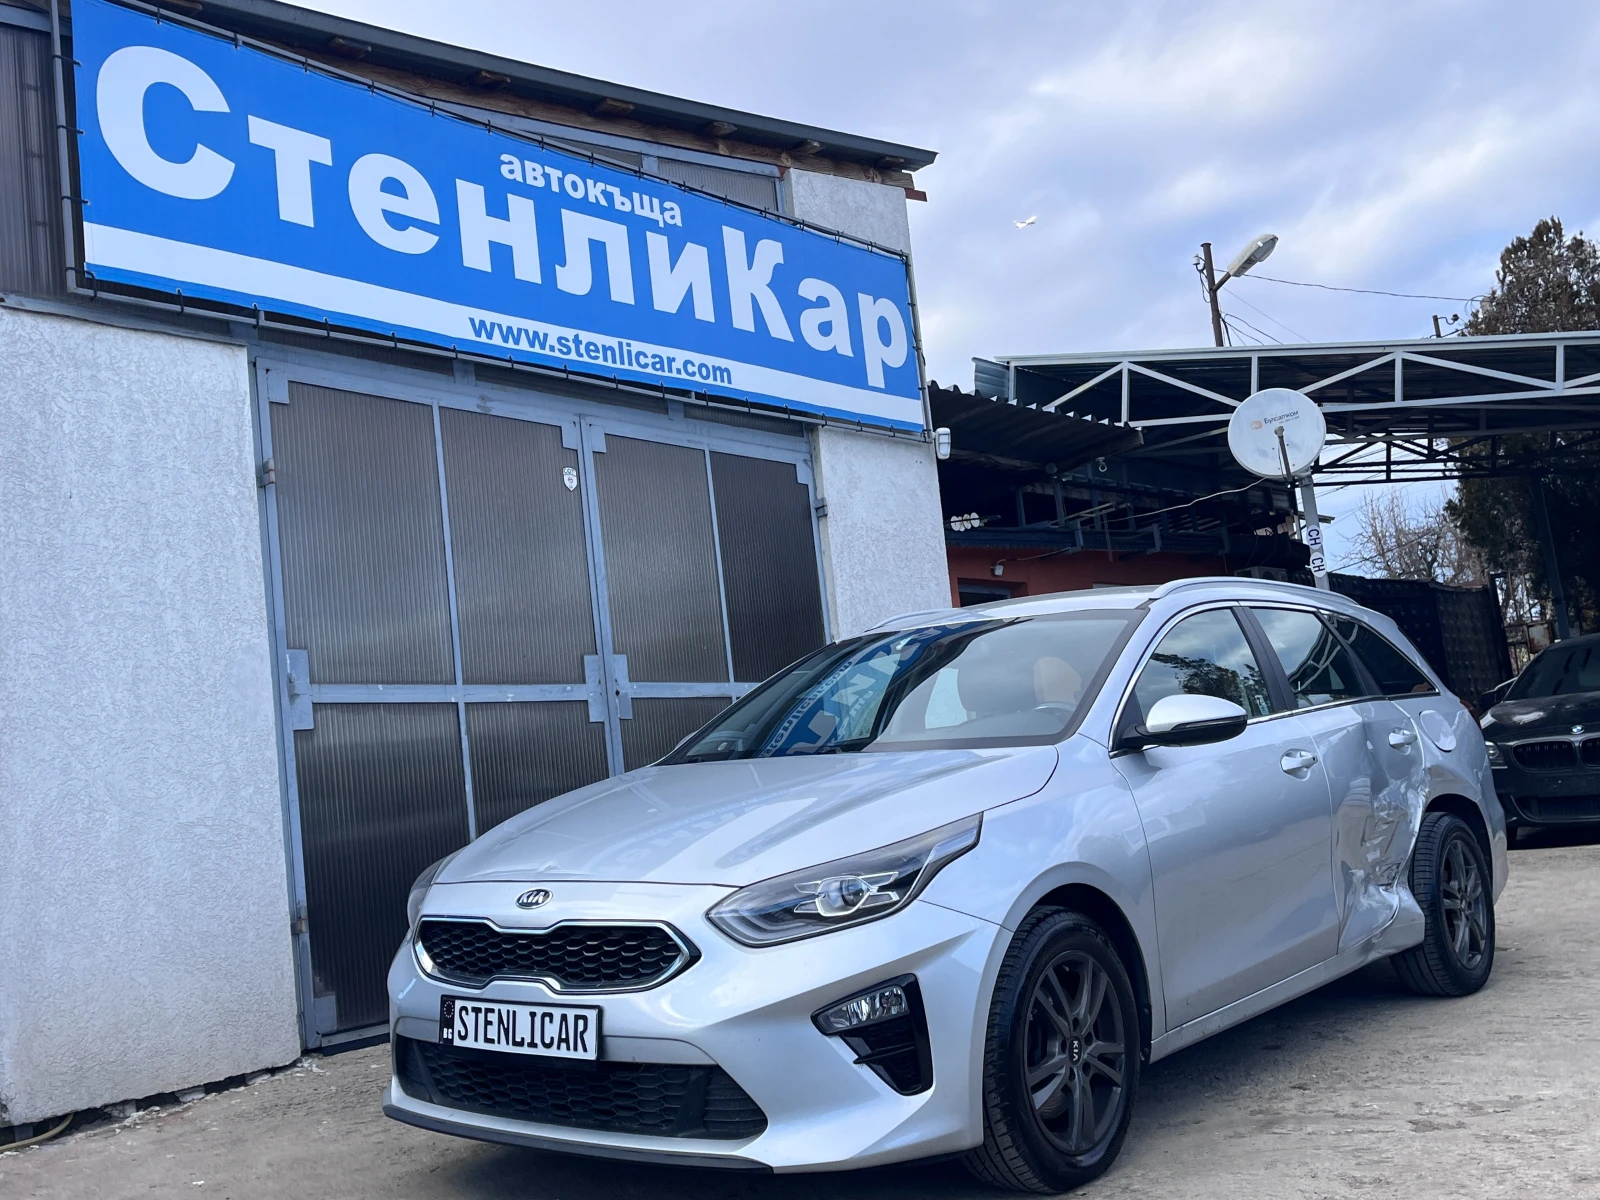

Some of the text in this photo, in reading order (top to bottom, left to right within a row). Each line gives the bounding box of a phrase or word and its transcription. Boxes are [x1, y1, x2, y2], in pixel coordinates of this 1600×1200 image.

[501, 153, 682, 227] автокъща
[96, 45, 908, 388] СтенлиКар
[469, 317, 733, 385] www.stenlicar.com
[1308, 528, 1321, 546] CH
[1311, 557, 1325, 573] CH
[518, 891, 546, 904] KIA
[443, 1028, 453, 1040] BG
[457, 1005, 588, 1053] STENLICAR
